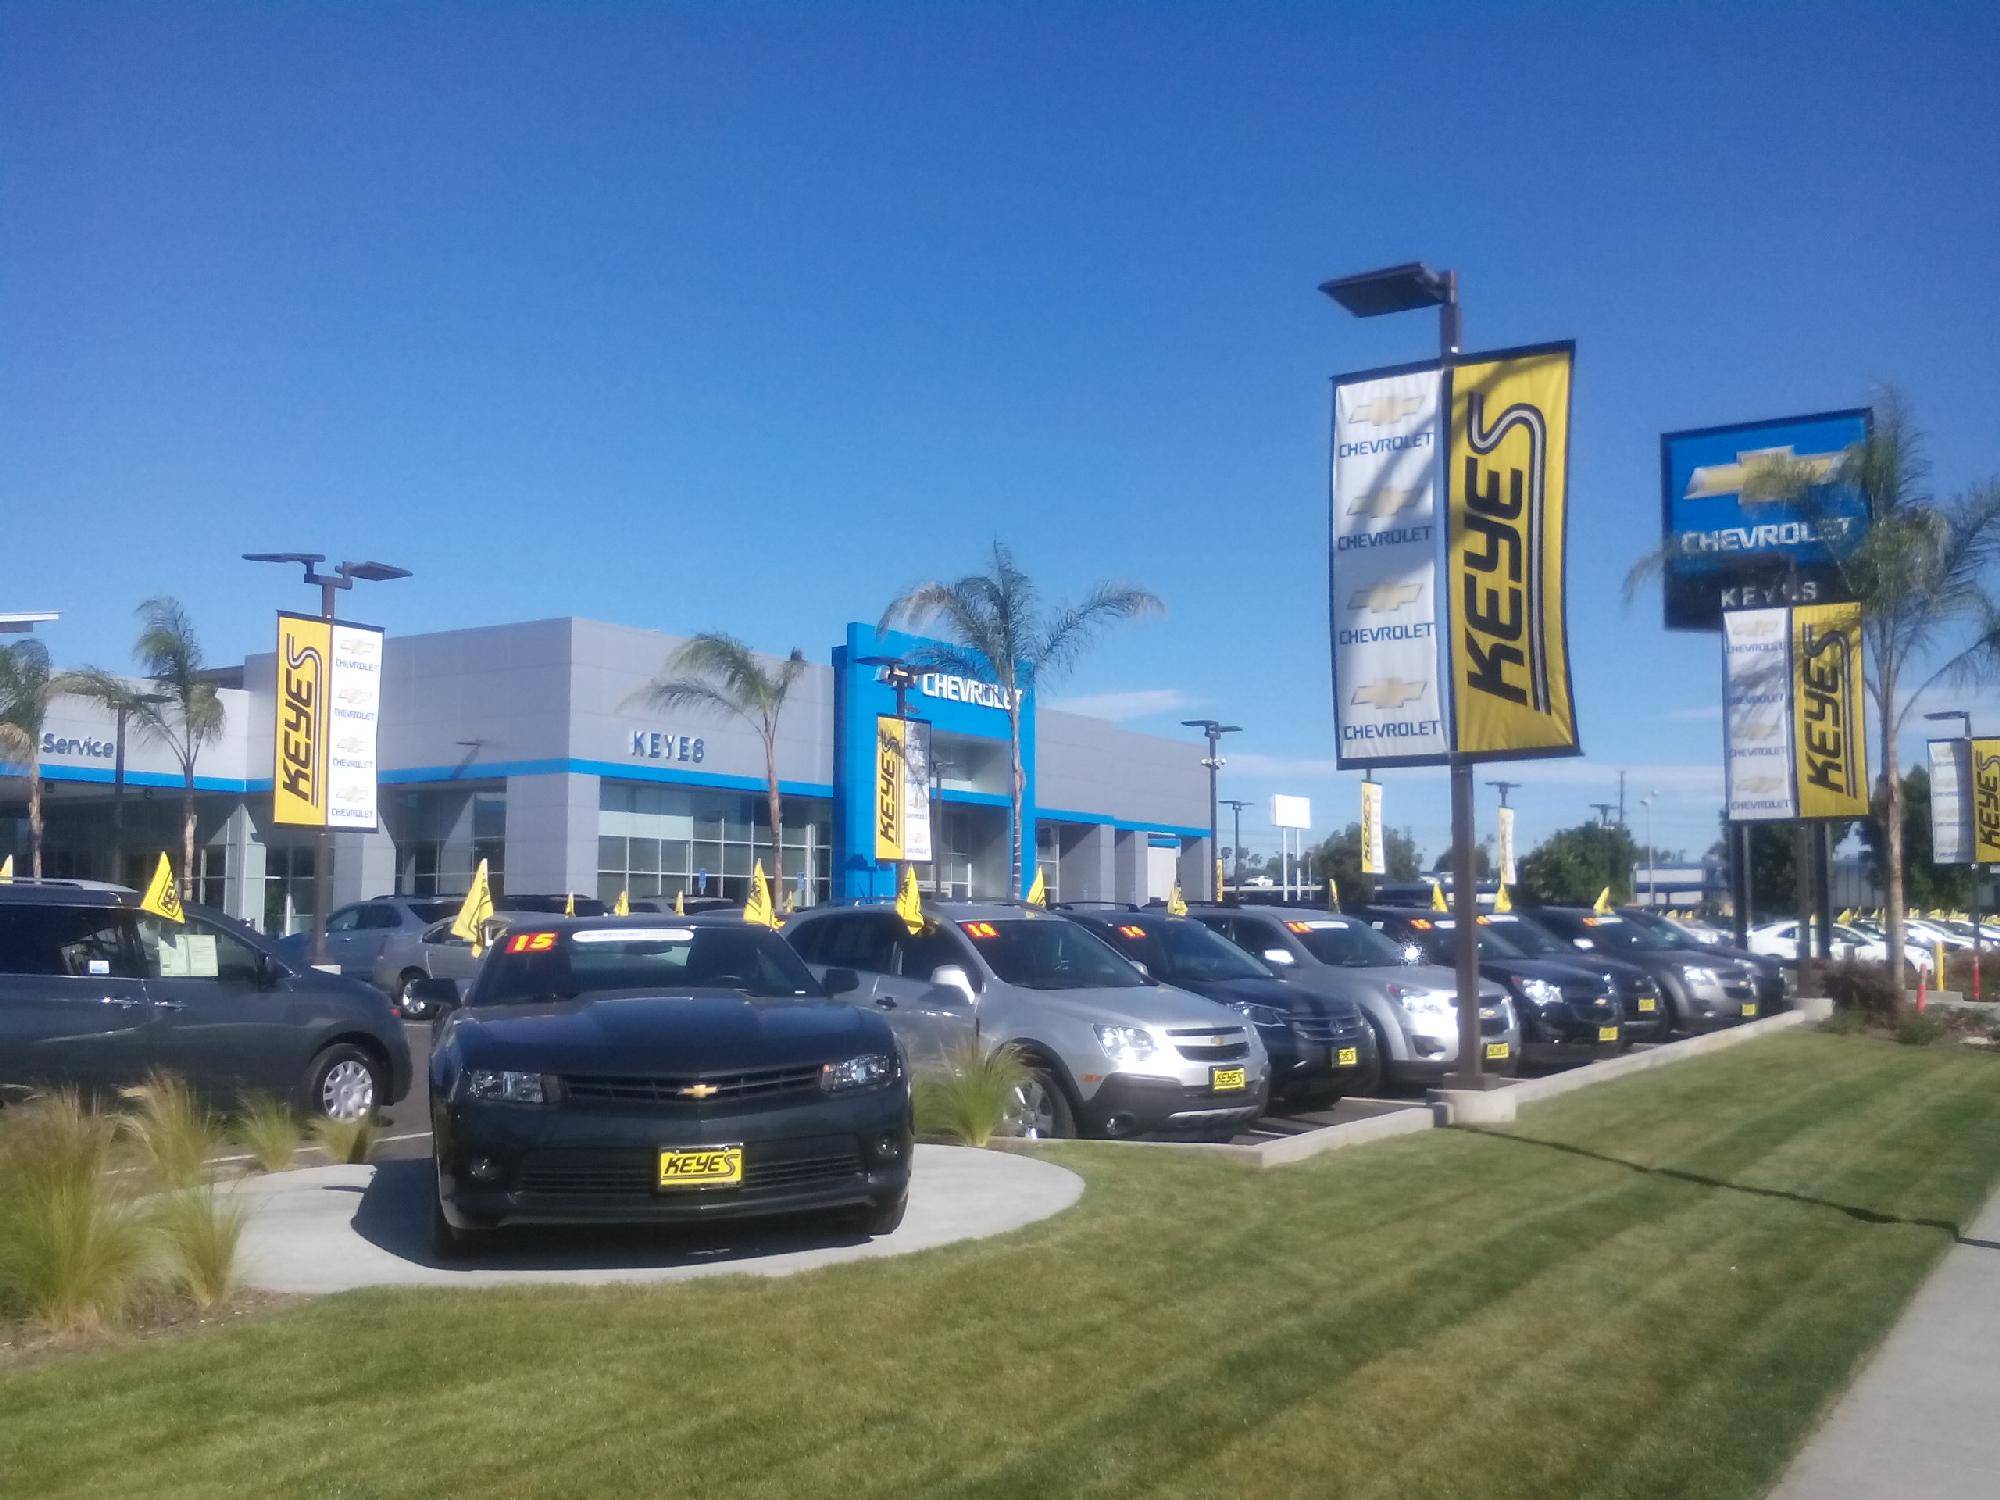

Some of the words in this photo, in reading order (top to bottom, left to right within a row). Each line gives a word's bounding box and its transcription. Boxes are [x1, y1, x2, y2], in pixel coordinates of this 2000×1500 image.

[1339, 432, 1434, 459] CHEVROLET
[1337, 525, 1433, 551] CHEVROLET
[1463, 391, 1551, 716] KEYES
[1339, 622, 1435, 645] CHEVROLET
[282, 632, 322, 808] KEYES
[1802, 621, 1857, 799] KEYES
[1343, 719, 1440, 741] CHEVROLET
[42, 732, 114, 758] Service
[629, 730, 704, 764] KEYES
[880, 727, 901, 849] KEYES
[1730, 799, 1791, 811] CHEVROLET
[514, 932, 556, 952] 15
[663, 1153, 741, 1179] KEYES
